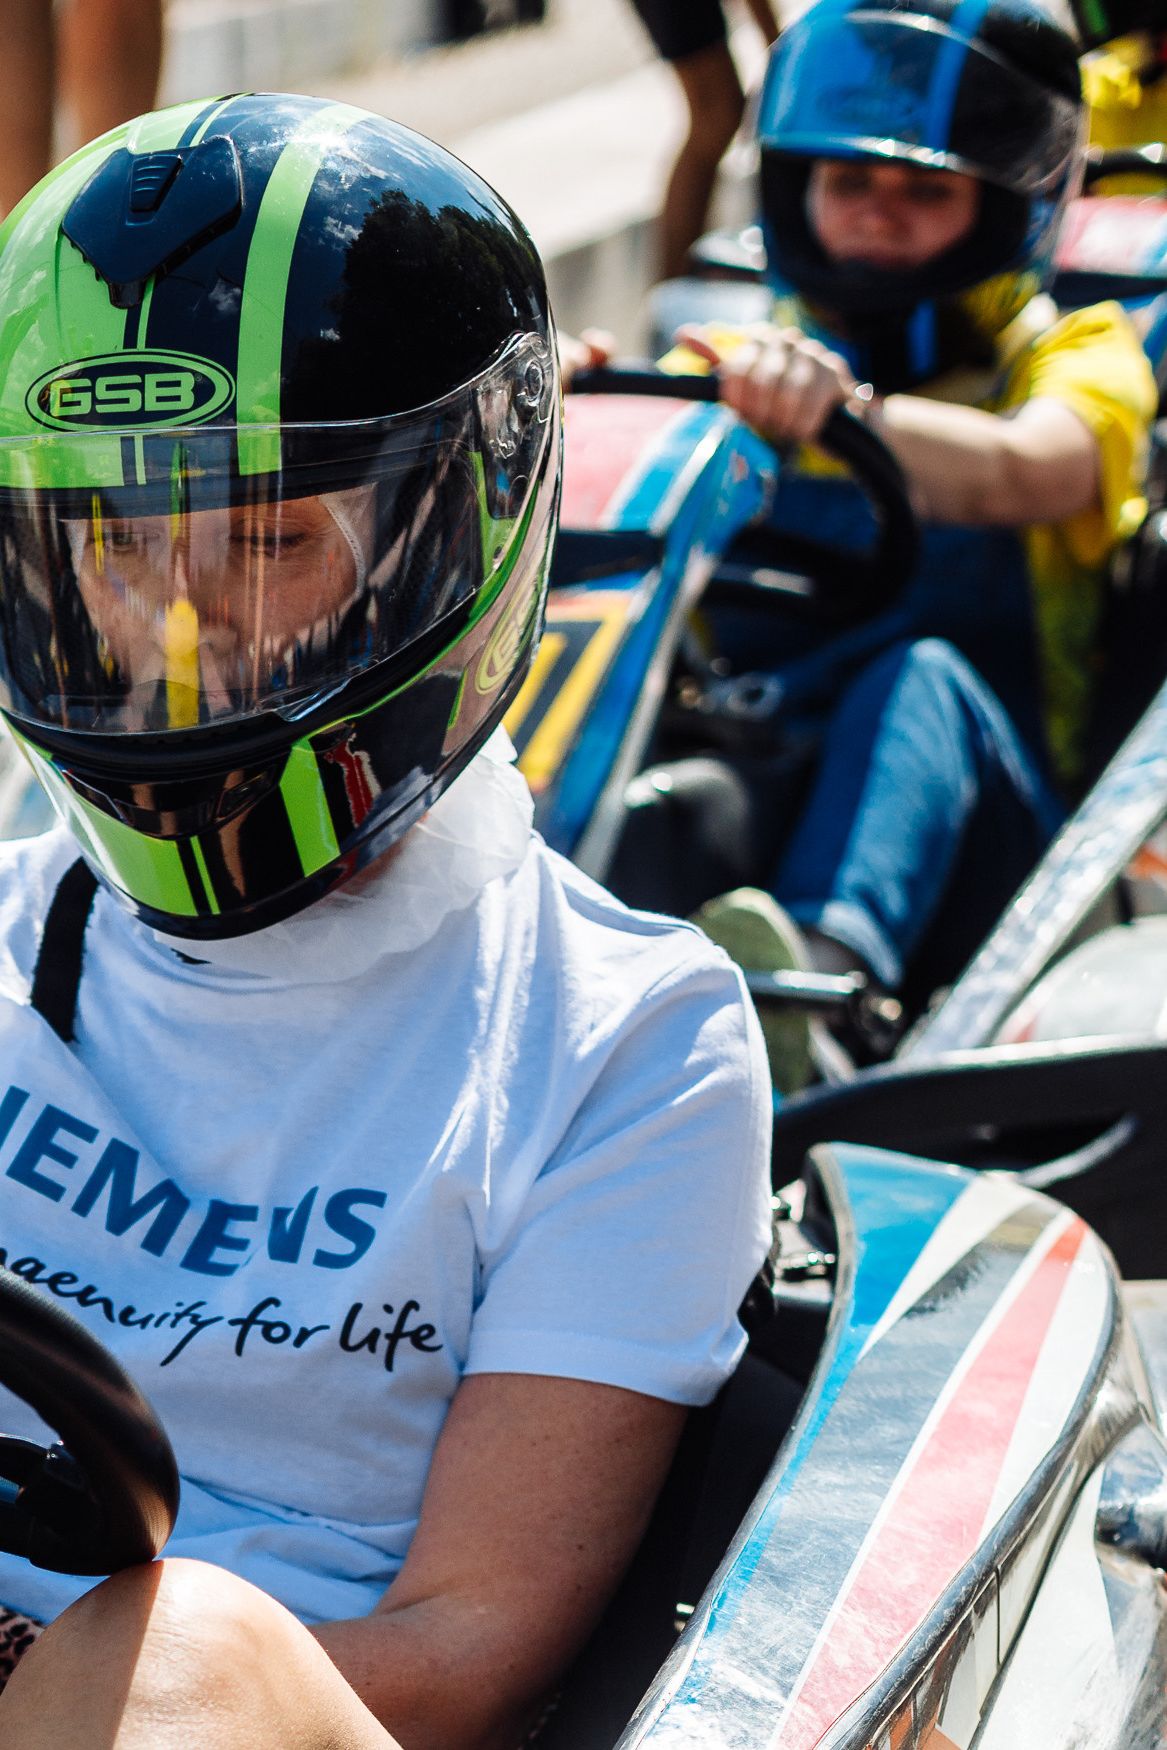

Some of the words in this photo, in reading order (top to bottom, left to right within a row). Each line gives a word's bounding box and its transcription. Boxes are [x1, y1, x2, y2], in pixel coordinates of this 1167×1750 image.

[49, 371, 195, 417] GSB
[229, 1296, 331, 1357] for
[339, 1299, 444, 1372] life
